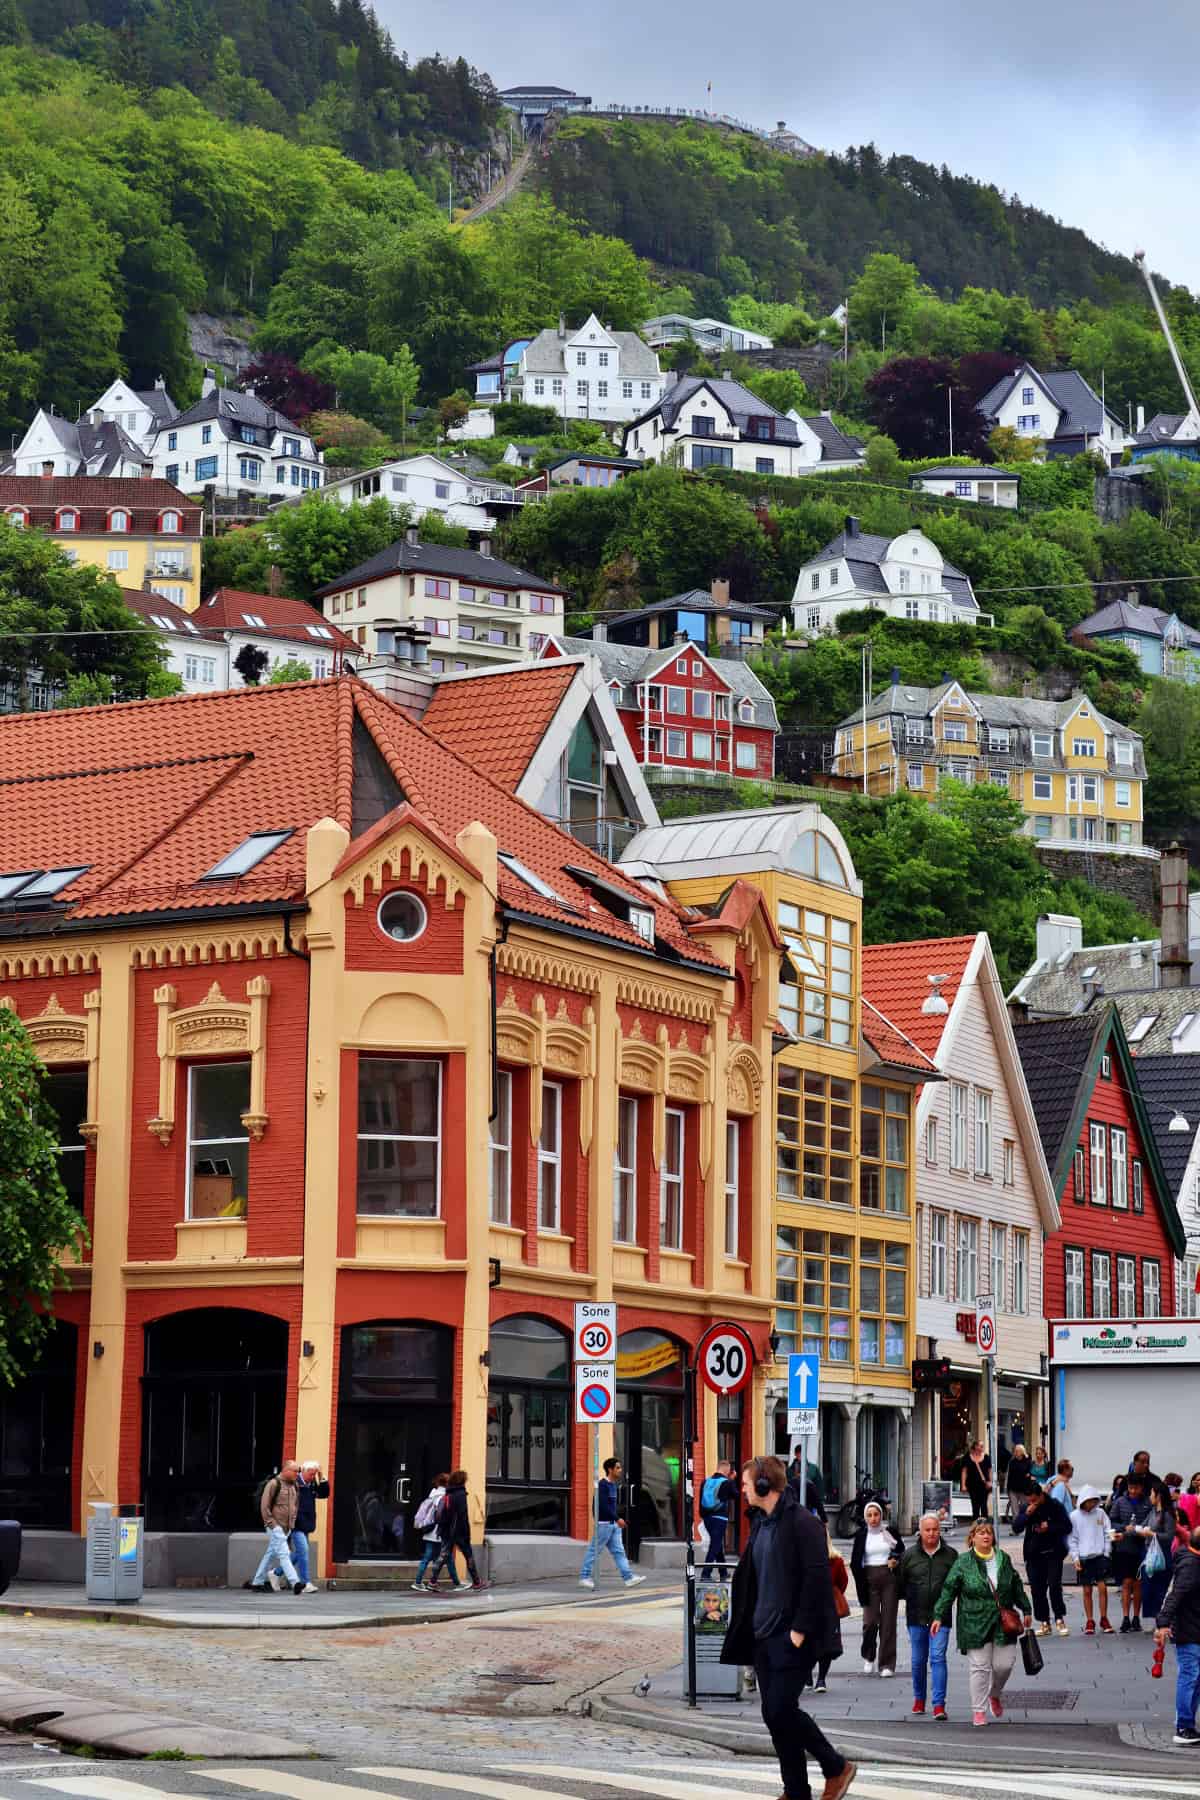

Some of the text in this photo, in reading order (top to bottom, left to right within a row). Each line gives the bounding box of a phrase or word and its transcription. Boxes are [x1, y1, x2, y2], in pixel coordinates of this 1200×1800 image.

[582, 1306, 610, 1316] Sone
[585, 1331, 606, 1348] 30
[982, 1324, 992, 1341] 30
[710, 1343, 744, 1378] 30
[582, 1368, 609, 1378] Sone
